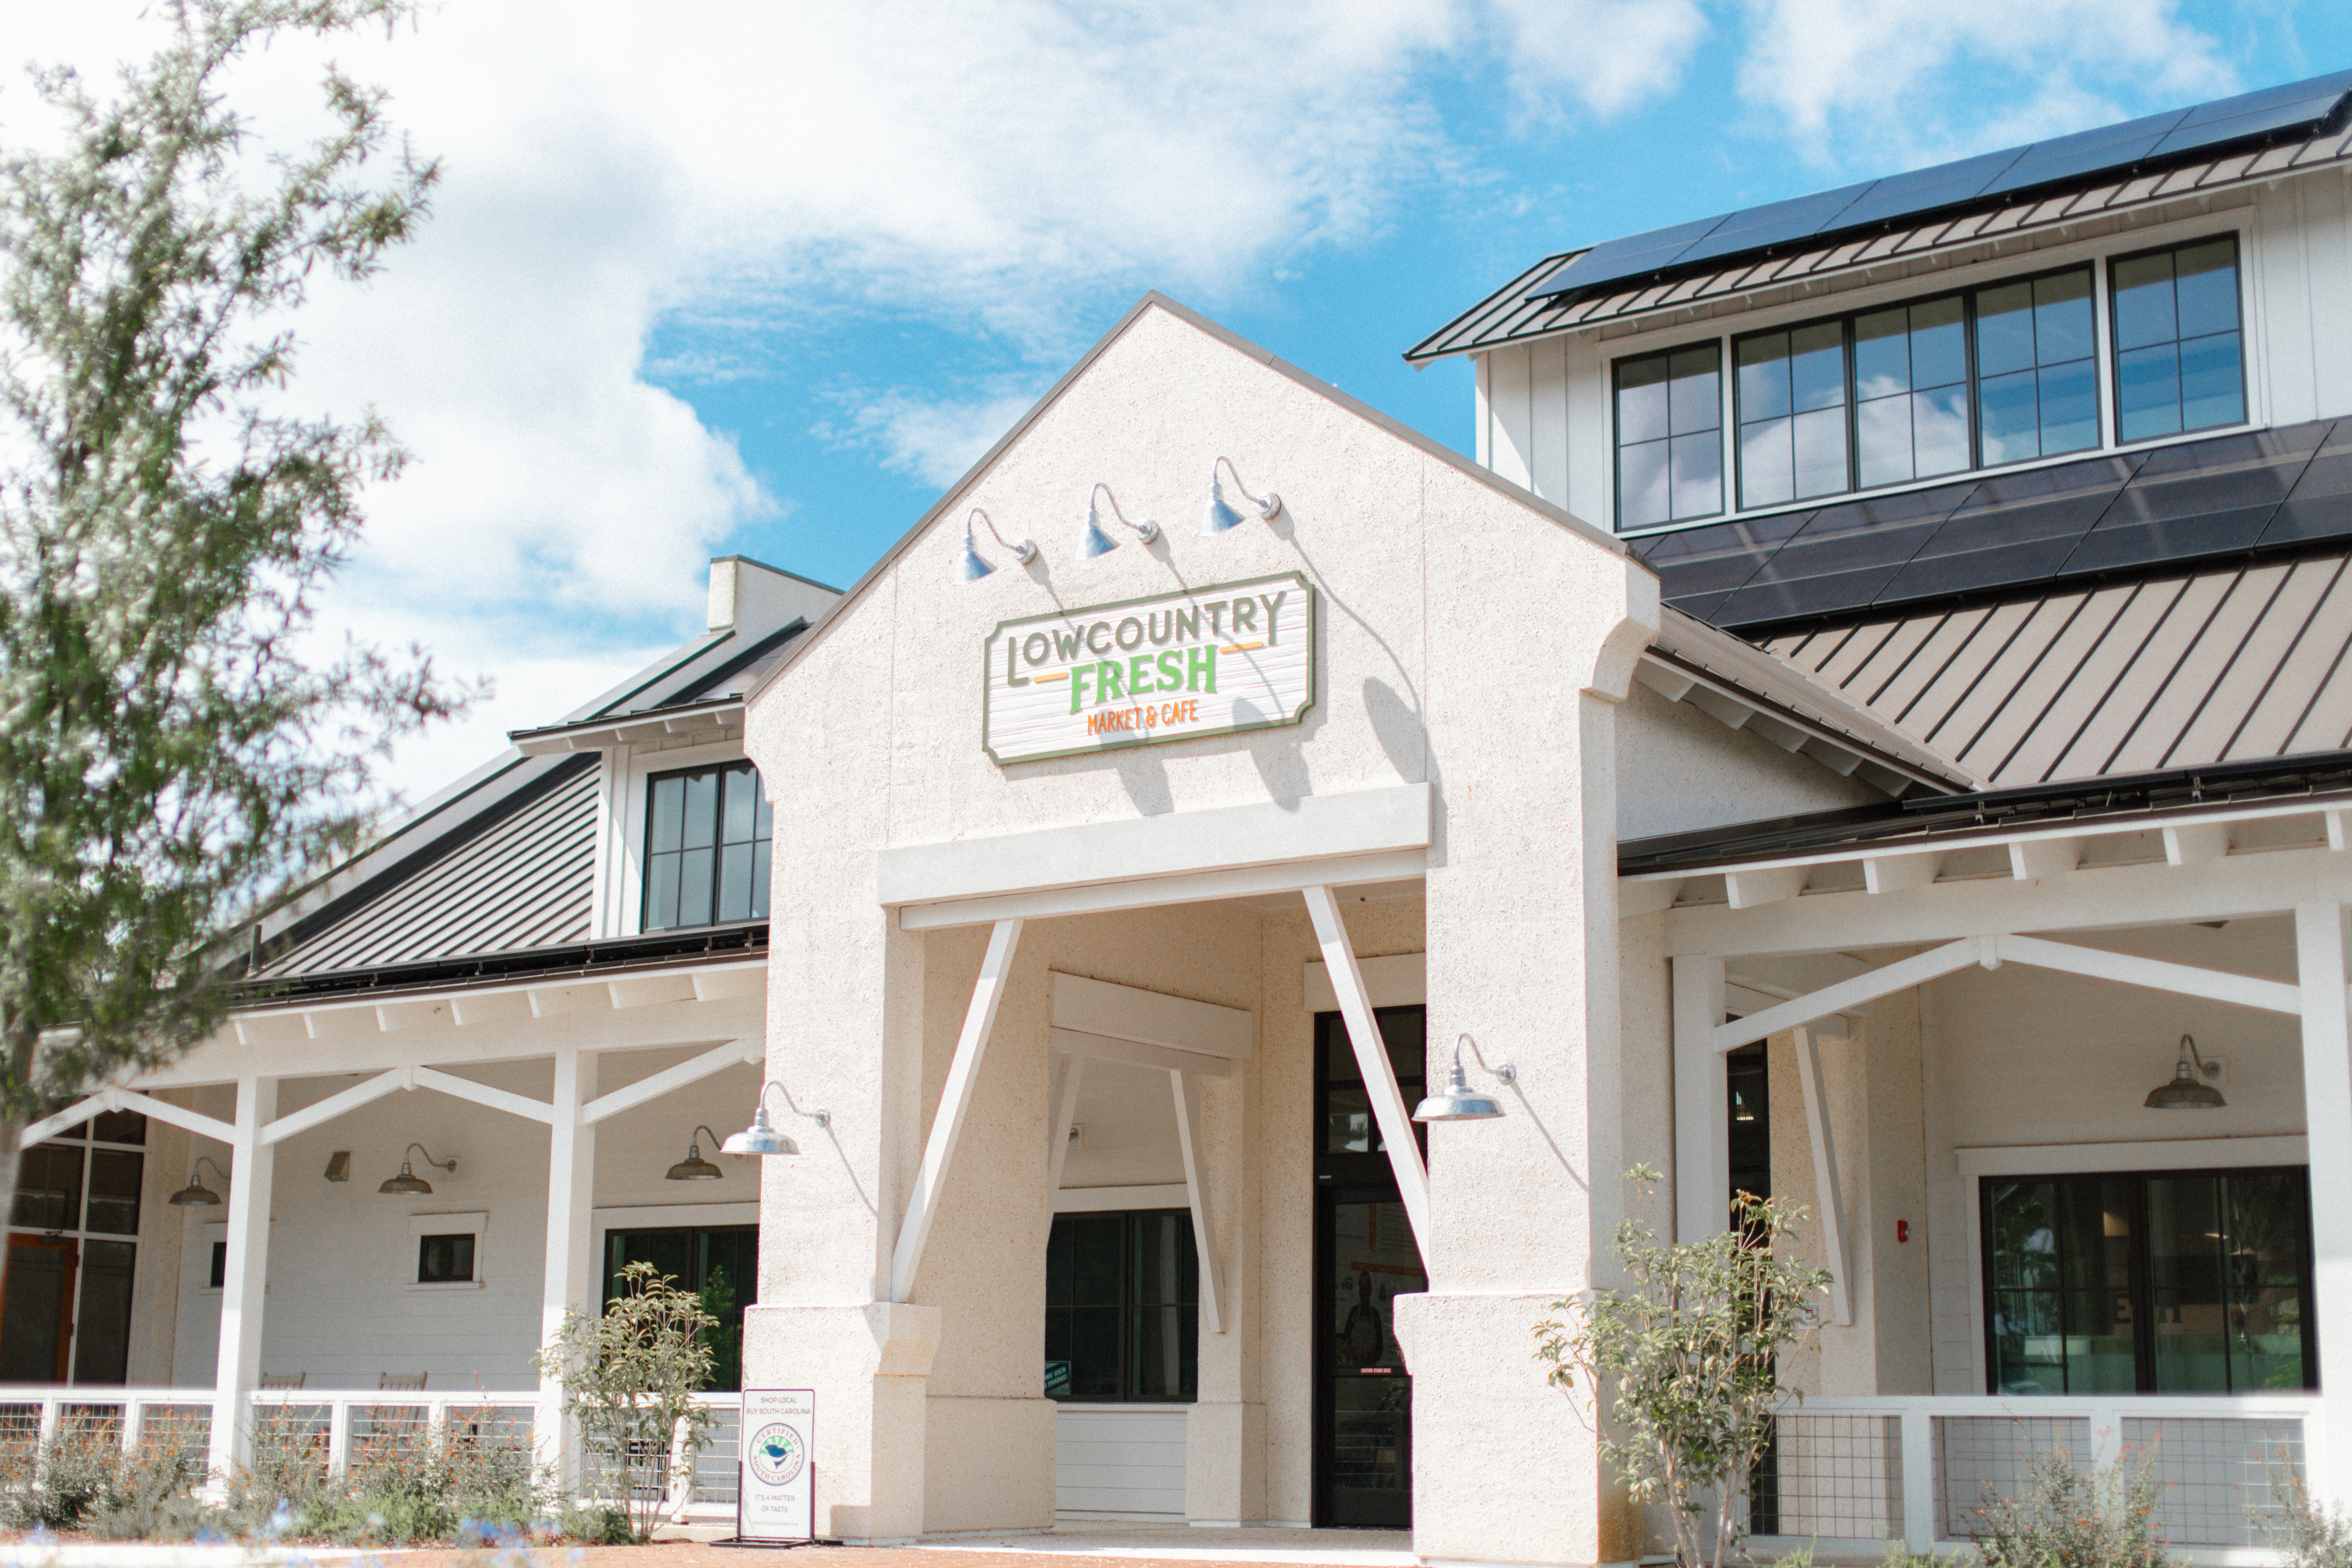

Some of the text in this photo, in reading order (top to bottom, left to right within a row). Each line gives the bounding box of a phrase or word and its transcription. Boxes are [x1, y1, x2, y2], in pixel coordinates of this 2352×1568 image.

[1008, 591, 1285, 686] LOWCOUNTRY
[1069, 644, 1216, 714] FRESH
[1088, 699, 1197, 735] MARKET & CAFE
[757, 1428, 798, 1445] CERTIFIED
[753, 1454, 801, 1482] SOUTH CAROLINA
